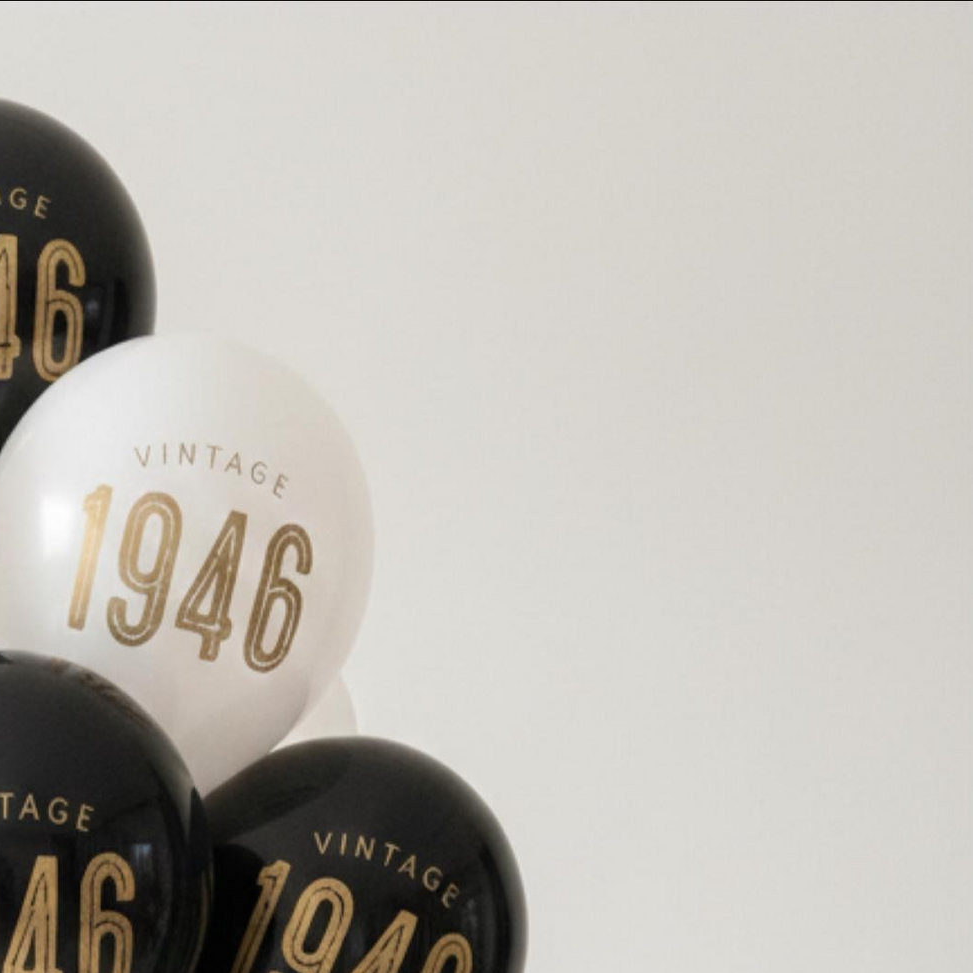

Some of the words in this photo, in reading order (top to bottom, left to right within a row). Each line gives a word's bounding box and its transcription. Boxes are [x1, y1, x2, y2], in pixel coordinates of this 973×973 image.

[134, 443, 289, 498] VINTAGE
[67, 484, 313, 673] 1946
[314, 832, 460, 908] VINTAGE
